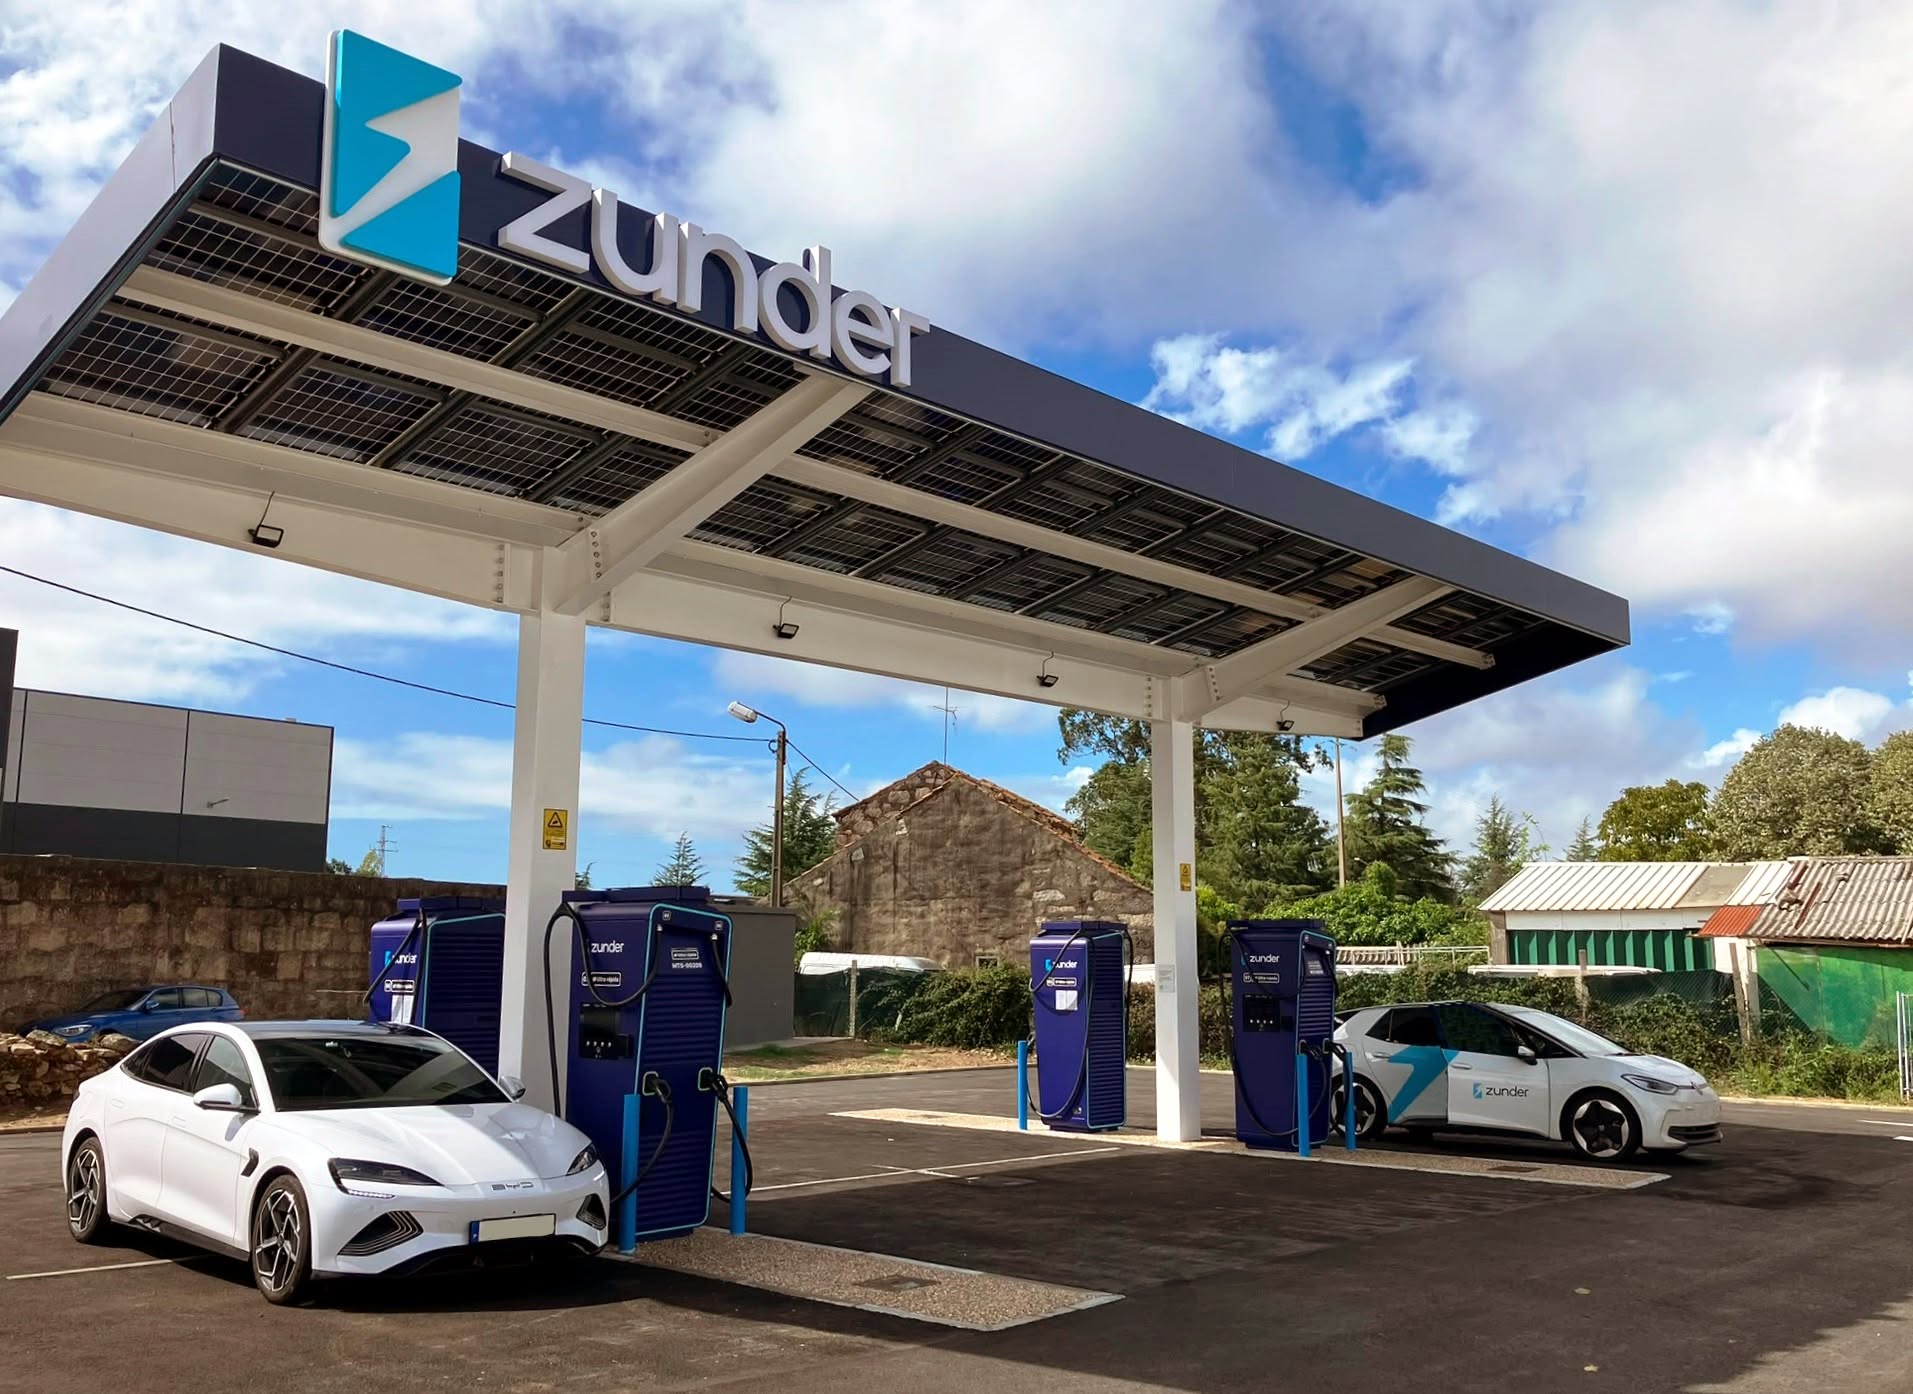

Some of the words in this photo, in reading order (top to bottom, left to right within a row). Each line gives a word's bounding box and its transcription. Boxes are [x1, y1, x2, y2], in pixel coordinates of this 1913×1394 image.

[498, 151, 931, 387] zunder
[591, 940, 625, 953] zunder
[1249, 953, 1280, 963] zunder
[1485, 1086, 1529, 1098] zunder
